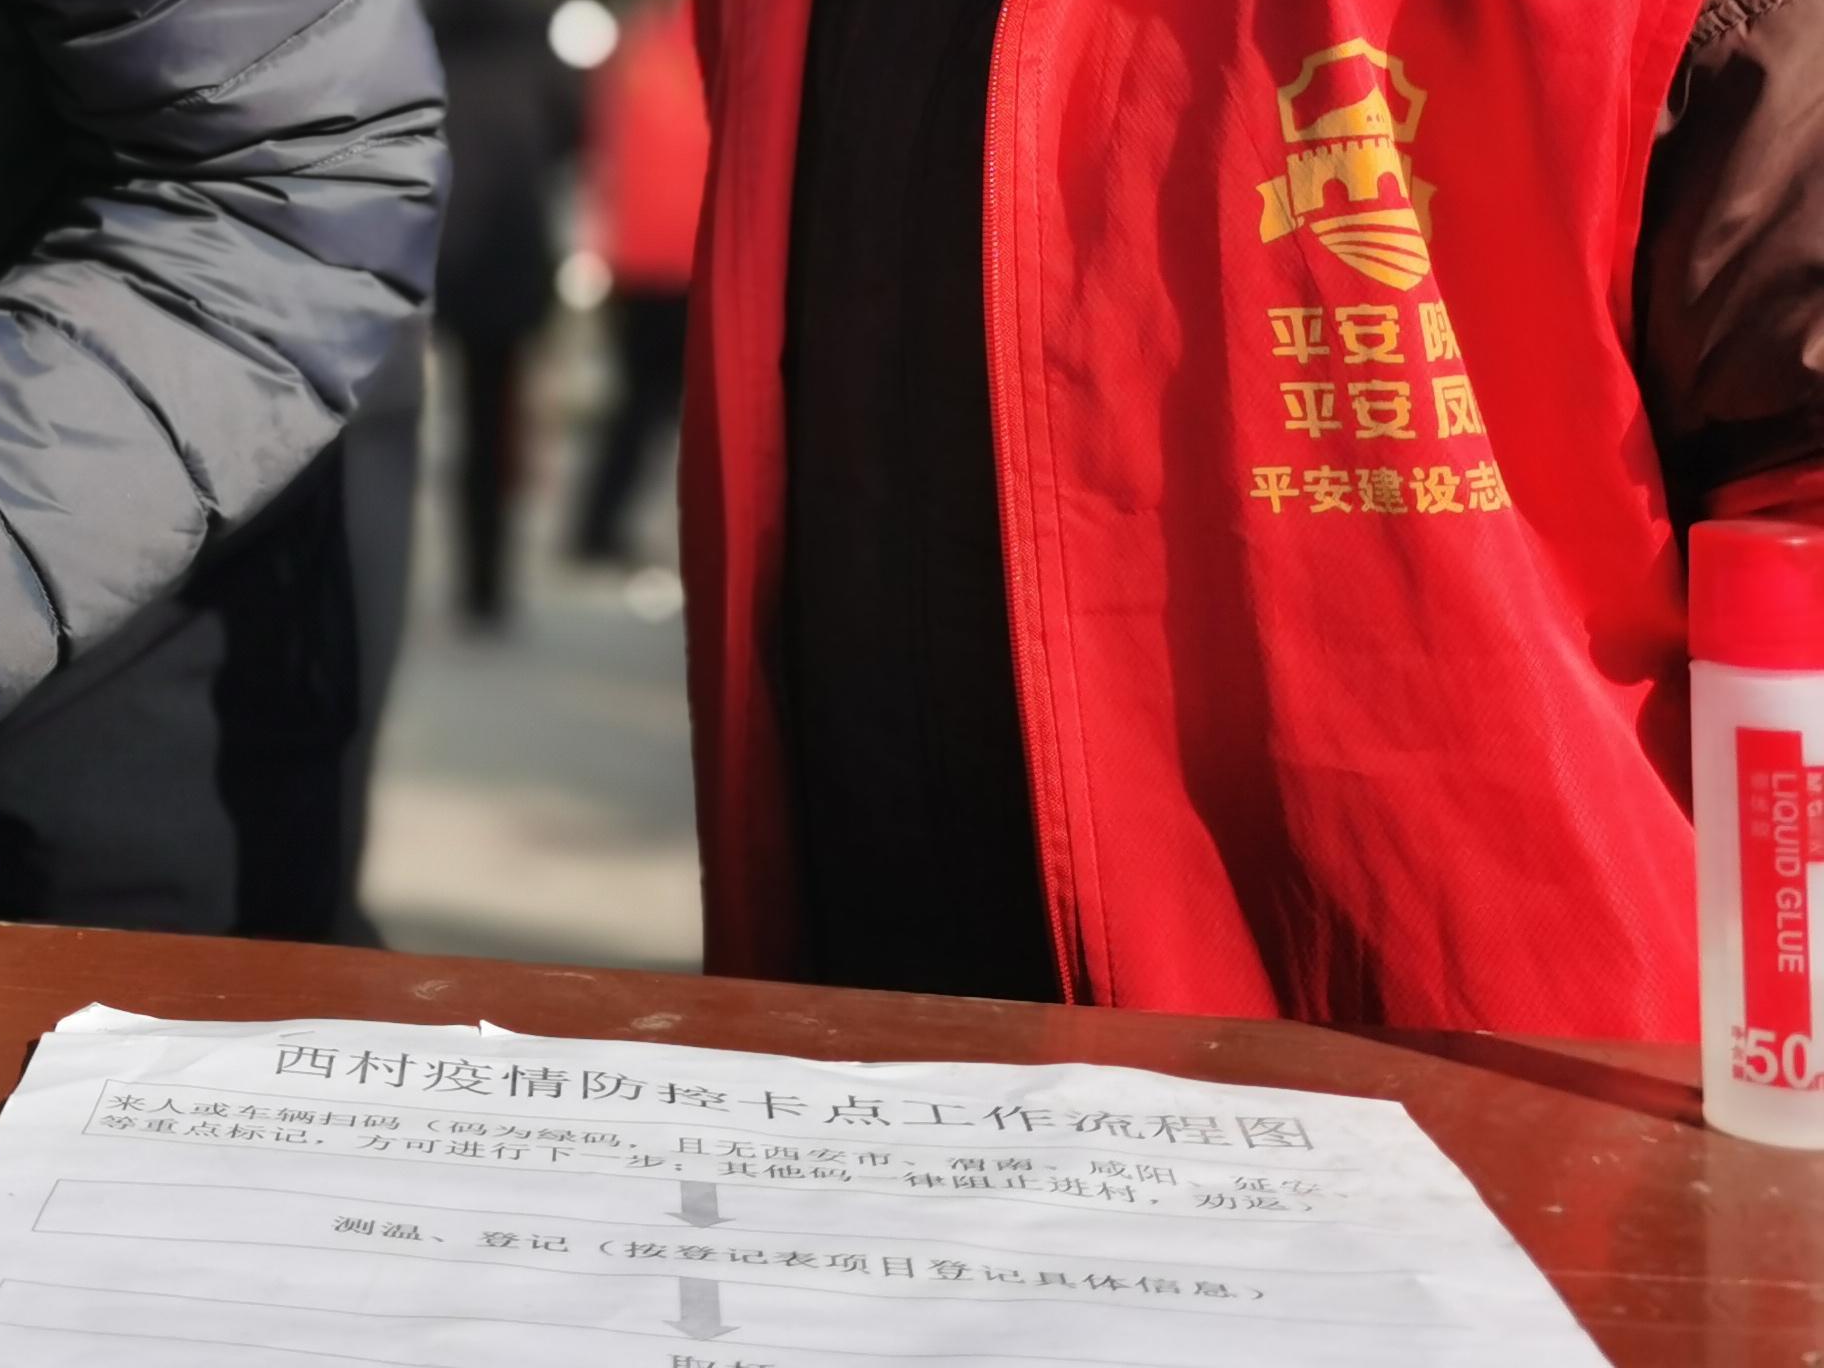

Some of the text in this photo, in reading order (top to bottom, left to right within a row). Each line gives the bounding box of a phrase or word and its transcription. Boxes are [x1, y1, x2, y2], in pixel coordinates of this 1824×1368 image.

[1771, 772, 1805, 974] LIQUID GLUE
[275, 1043, 1314, 1150] 西村疫情防控卡点工作流程图
